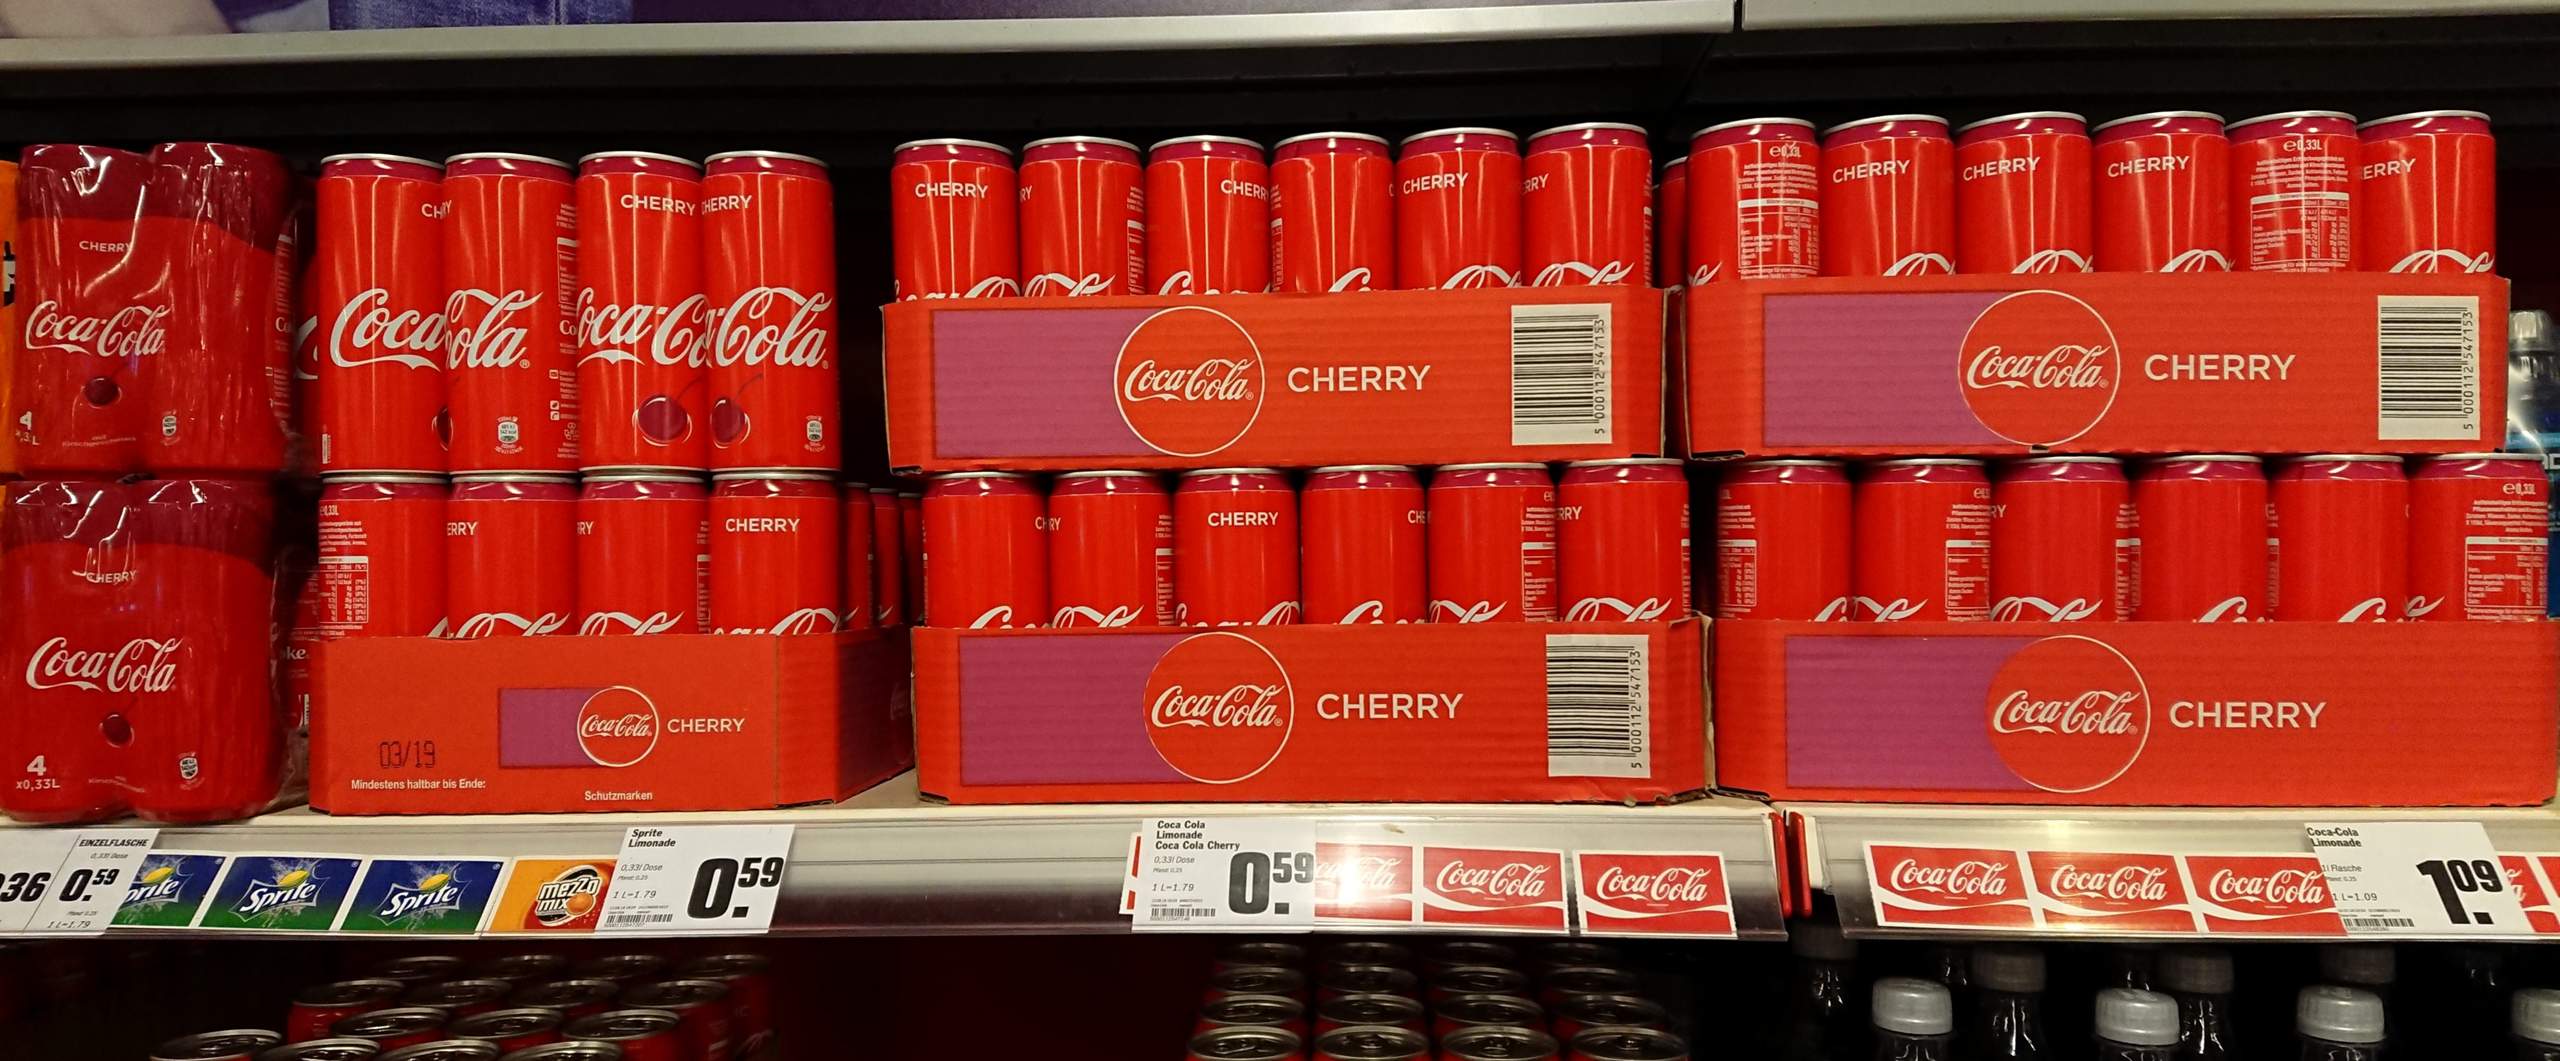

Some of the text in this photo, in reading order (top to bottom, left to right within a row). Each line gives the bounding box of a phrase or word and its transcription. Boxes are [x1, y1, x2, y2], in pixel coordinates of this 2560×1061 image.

[1832, 160, 1910, 183] CHERRY
[1963, 156, 2041, 181] CHERRY
[2108, 156, 2190, 178] CHERRY
[2362, 158, 2417, 180] ERRY
[915, 182, 989, 200] CHERRY
[1402, 172, 1470, 194] CHERRY
[620, 194, 696, 216] CHERRY
[79, 240, 132, 253] CHERRY
[25, 300, 171, 358] Coca-Cola
[1967, 344, 2111, 389] Coca-Cola
[2144, 354, 2297, 381] CHERRY
[1124, 358, 1256, 402] Coca-Cola
[1286, 364, 1432, 392] CHERRY
[725, 518, 800, 533] CHERRY
[1208, 511, 1279, 527] CHERRY
[86, 569, 137, 584] CHERRY
[25, 637, 184, 693] Coca-Cola
[1151, 684, 1285, 728] Coca-Cola
[1316, 693, 1464, 720] CHERRY
[1993, 690, 2141, 735] Coca-Cola
[2168, 701, 2327, 728] CHERRY
[581, 713, 653, 737] Coca-Cola
[667, 718, 745, 733] CHERRY
[26, 755, 47, 776] 4
[351, 779, 486, 790] Mindestens haltbar bis Ende:
[584, 790, 654, 801] Schutzmarken
[631, 828, 663, 839] Sprite
[1156, 830, 1203, 839] Limonade
[1157, 820, 1206, 829] Coca Cola
[2306, 827, 2359, 837] Coca-Cola
[79, 839, 149, 847] EINZELFLASCHE
[627, 838, 676, 848] Limonade
[1155, 841, 1240, 852] Coca Cola Cherry
[2311, 838, 2362, 847] Limonade
[643, 863, 663, 871] Dose
[1175, 856, 1195, 864] Dose
[59, 868, 120, 902] 0.59
[687, 856, 785, 919] 0.59
[1228, 851, 1314, 915] 0.59
[1436, 860, 1551, 897] Coca-Cola
[1596, 866, 1712, 902] Coca-Cola
[1890, 858, 2008, 896] Coca-Cola
[2050, 863, 2167, 901] Coca-Cola
[2208, 868, 2326, 904] Coca-Cola
[240, 881, 316, 913] Sprite
[381, 884, 458, 917] Sprite
[2416, 860, 2504, 925] 1.09
[538, 899, 567, 911] mix
